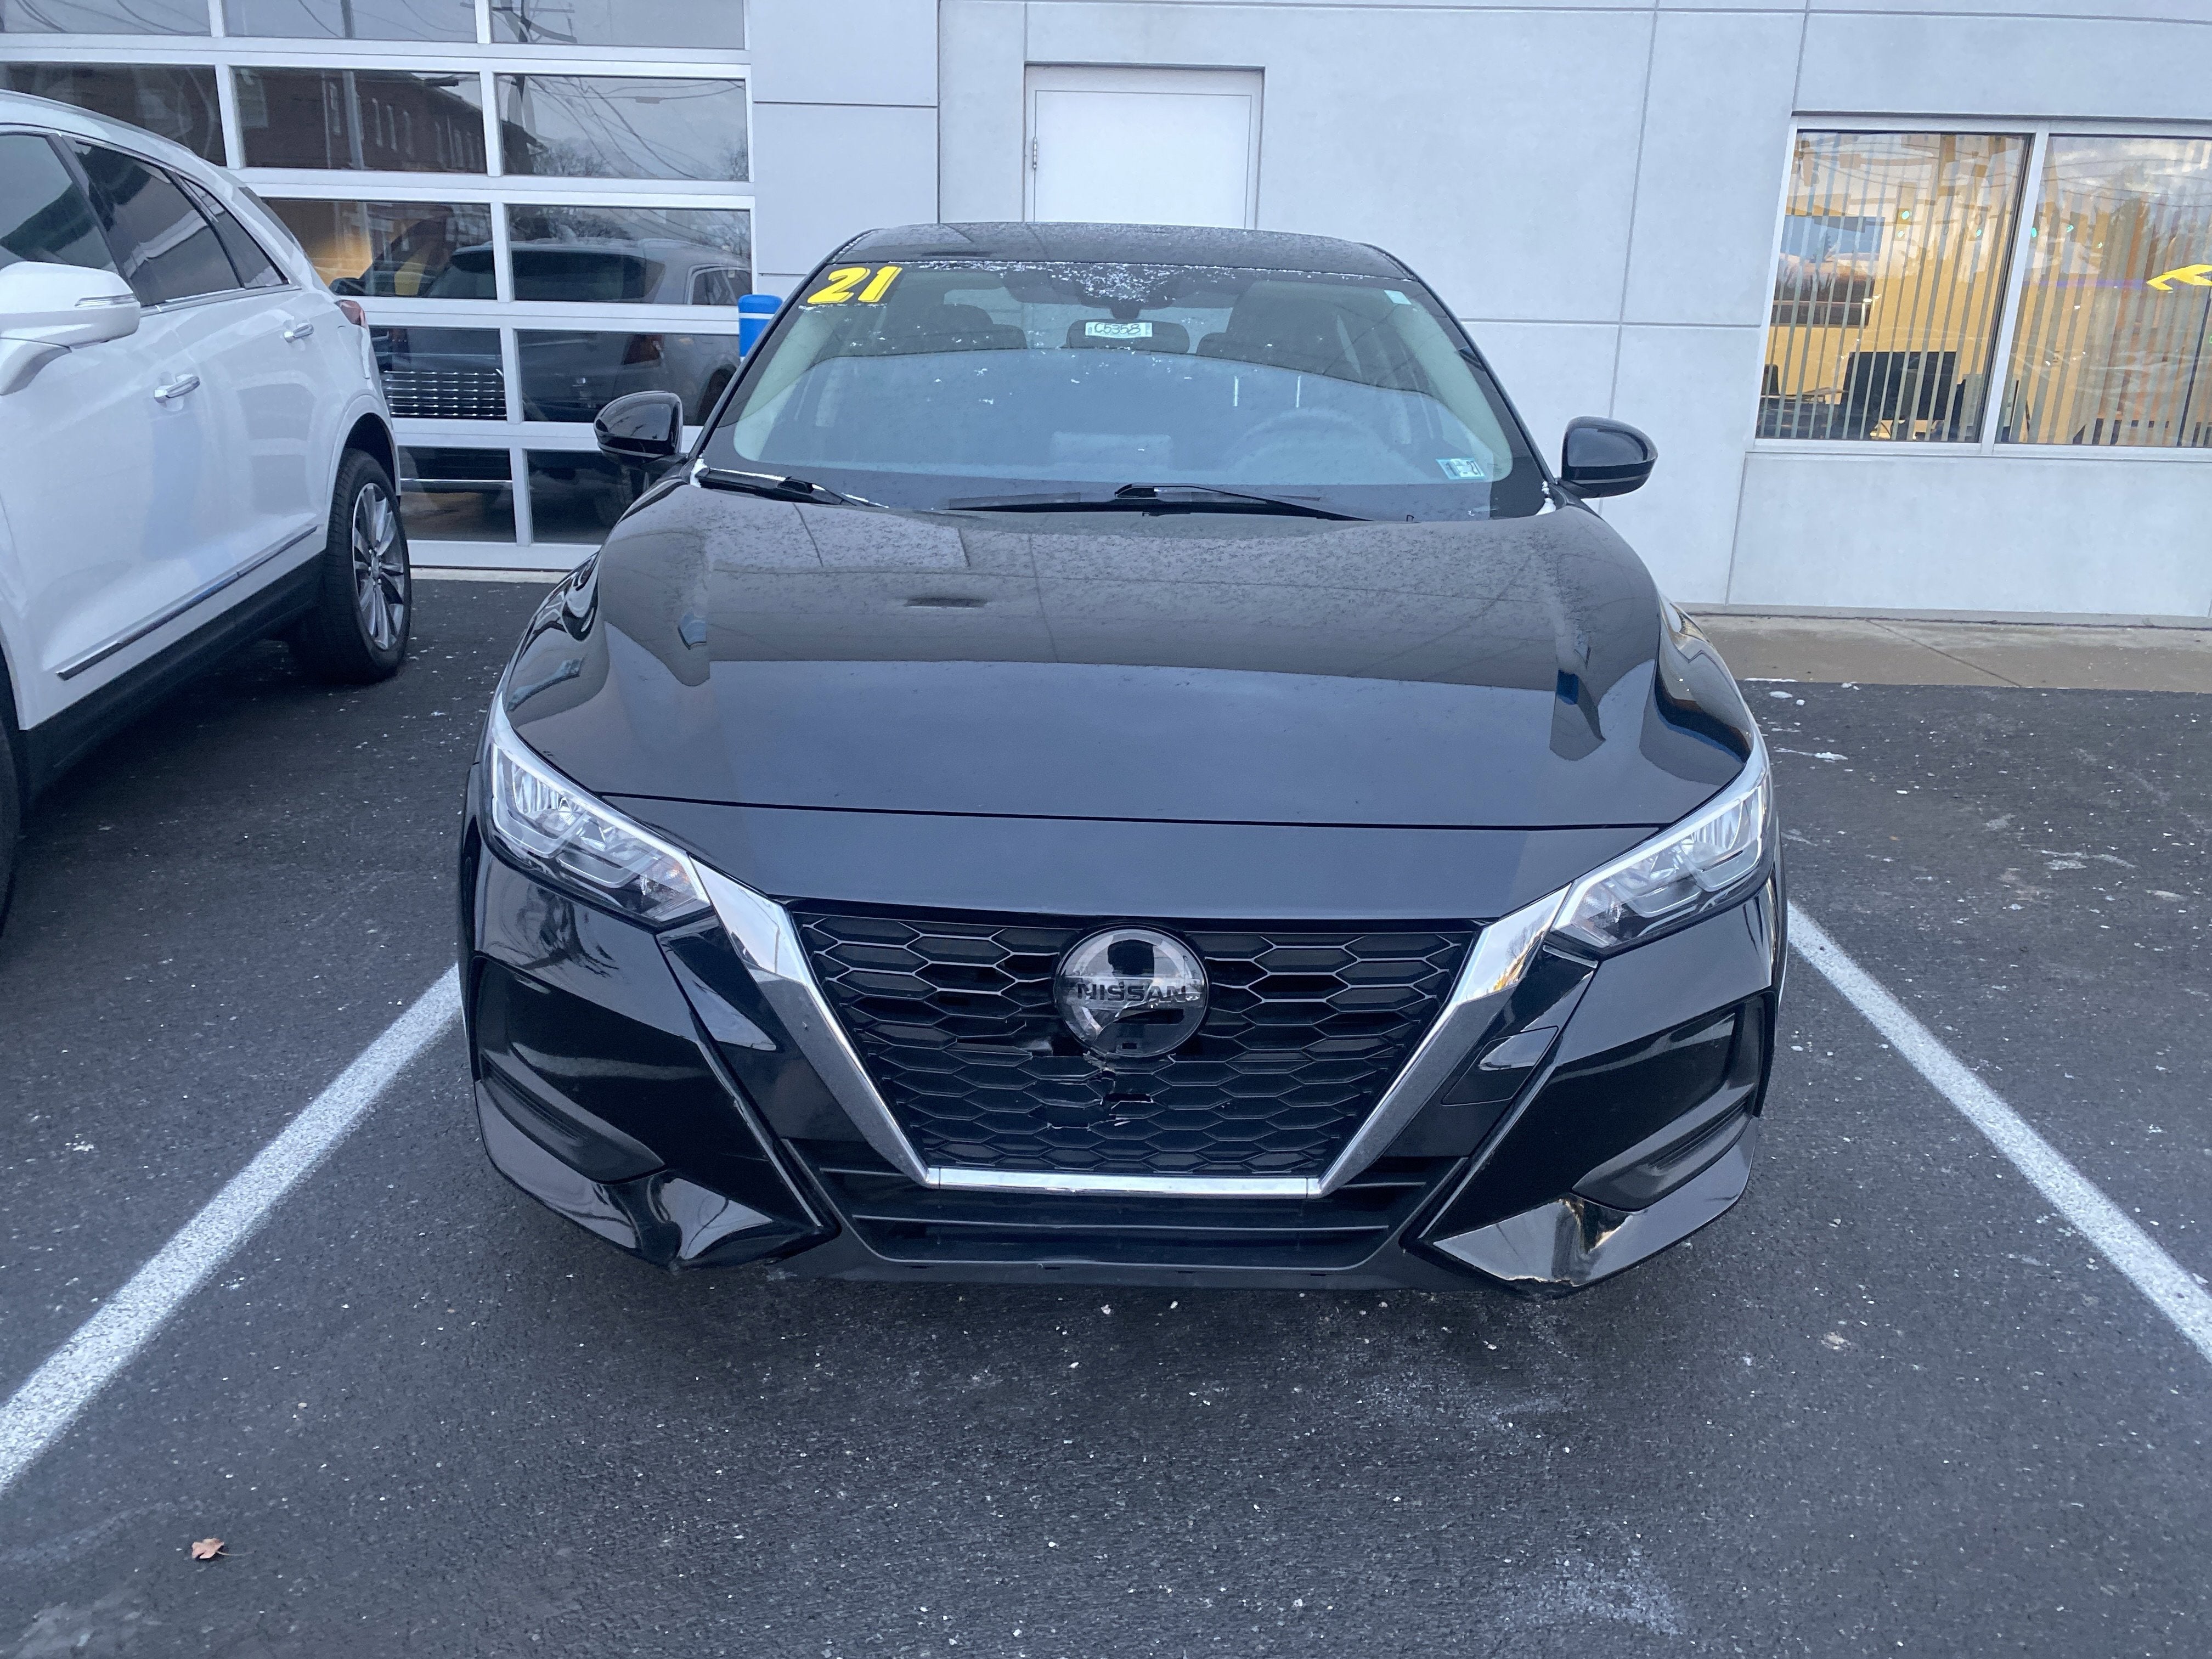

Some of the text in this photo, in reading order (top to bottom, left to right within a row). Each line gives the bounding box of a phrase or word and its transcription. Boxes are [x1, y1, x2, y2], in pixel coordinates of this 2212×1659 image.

[807, 266, 903, 304] 21
[1094, 323, 1141, 335] C5358
[1076, 983, 1186, 1002] NISSAN
